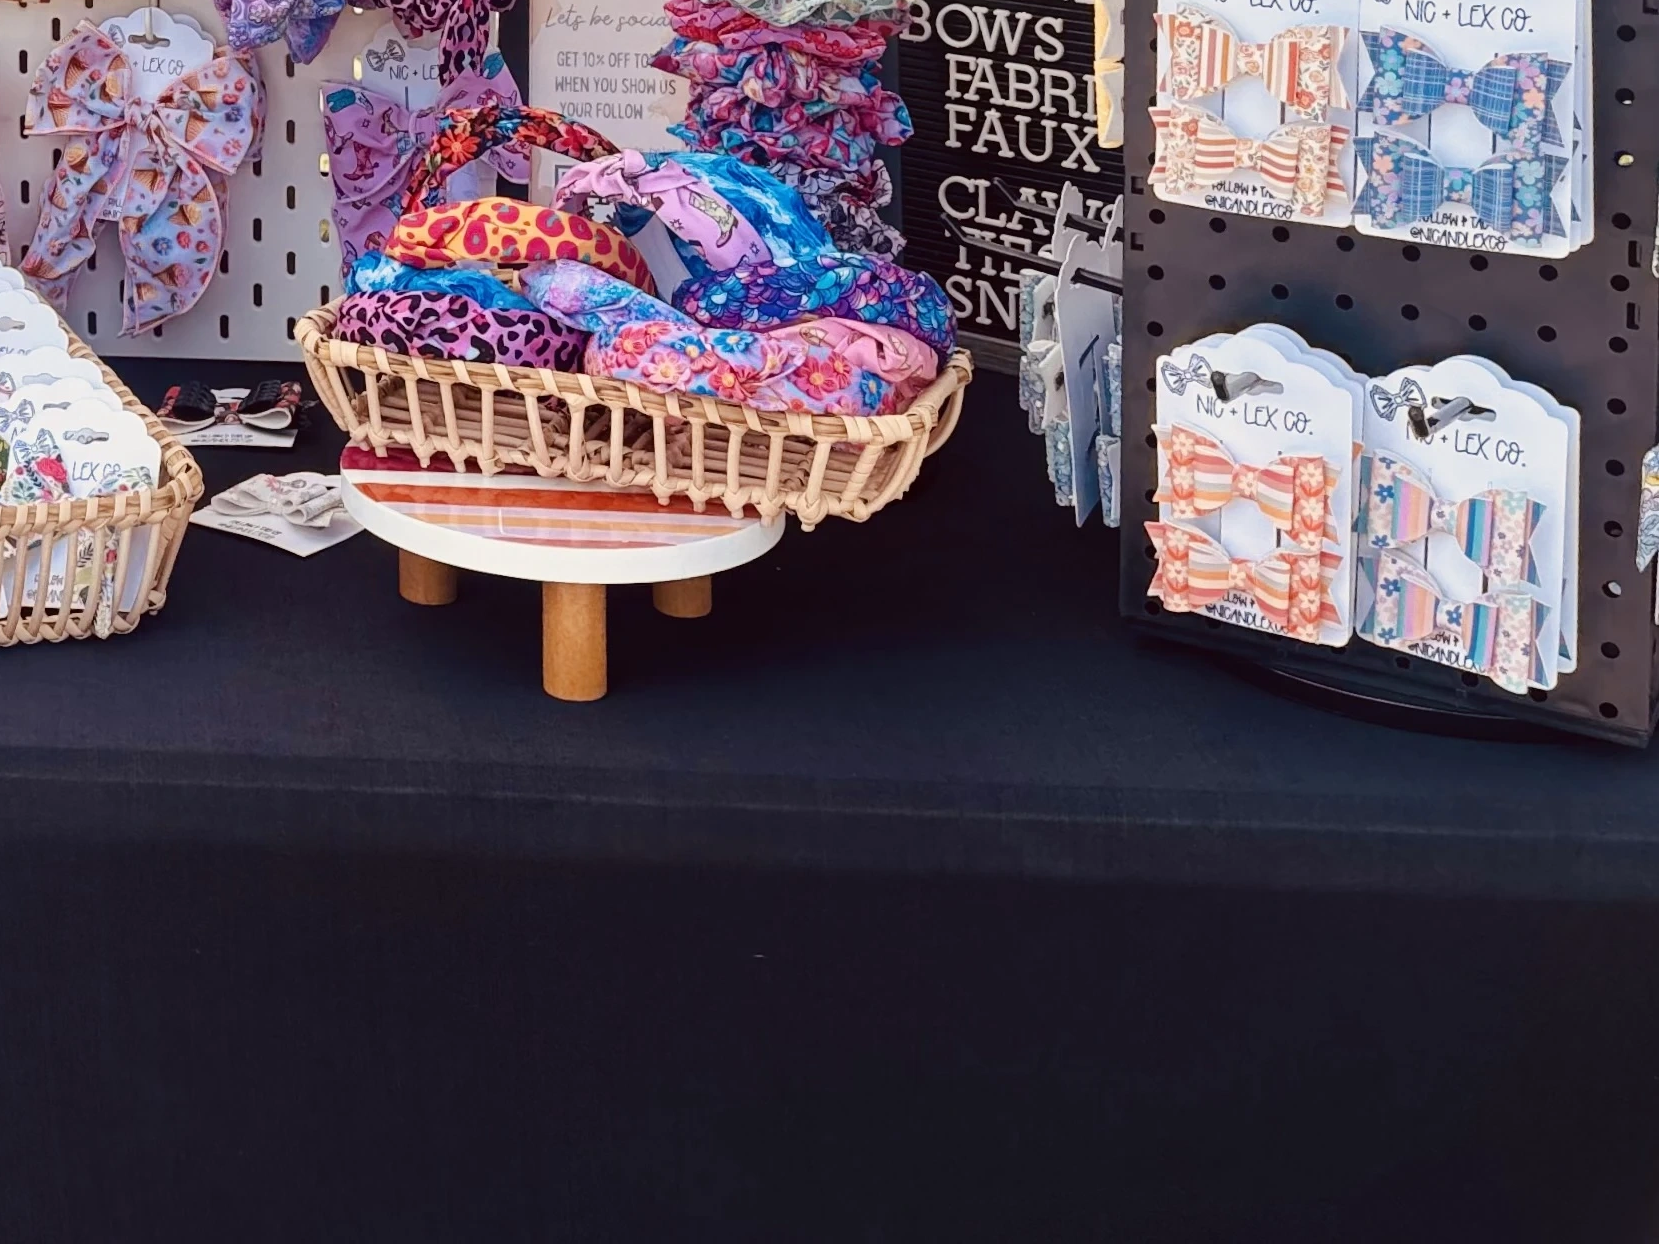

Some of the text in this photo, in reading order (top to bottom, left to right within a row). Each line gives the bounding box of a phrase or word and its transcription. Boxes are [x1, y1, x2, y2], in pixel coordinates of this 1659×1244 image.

[545, 4, 673, 31] Lets be socia
[1405, 0, 1436, 24] NIC
[1458, 4, 1495, 30] LEX
[899, 0, 1064, 62] BOWS
[142, 58, 164, 74] LEX
[557, 51, 580, 67] GET
[584, 52, 605, 66] 10%
[609, 53, 631, 68] OFF
[390, 65, 408, 80] NIC
[423, 64, 439, 80] LE
[556, 77, 676, 94] WHEN YOU SHOW US
[945, 53, 1098, 121] FABRI
[560, 102, 643, 119] YOUR FOLLOW
[945, 103, 1101, 173] FAUX
[1244, 406, 1278, 430] LEX
[1454, 430, 1491, 459] LEX
[72, 462, 99, 481] LEX
